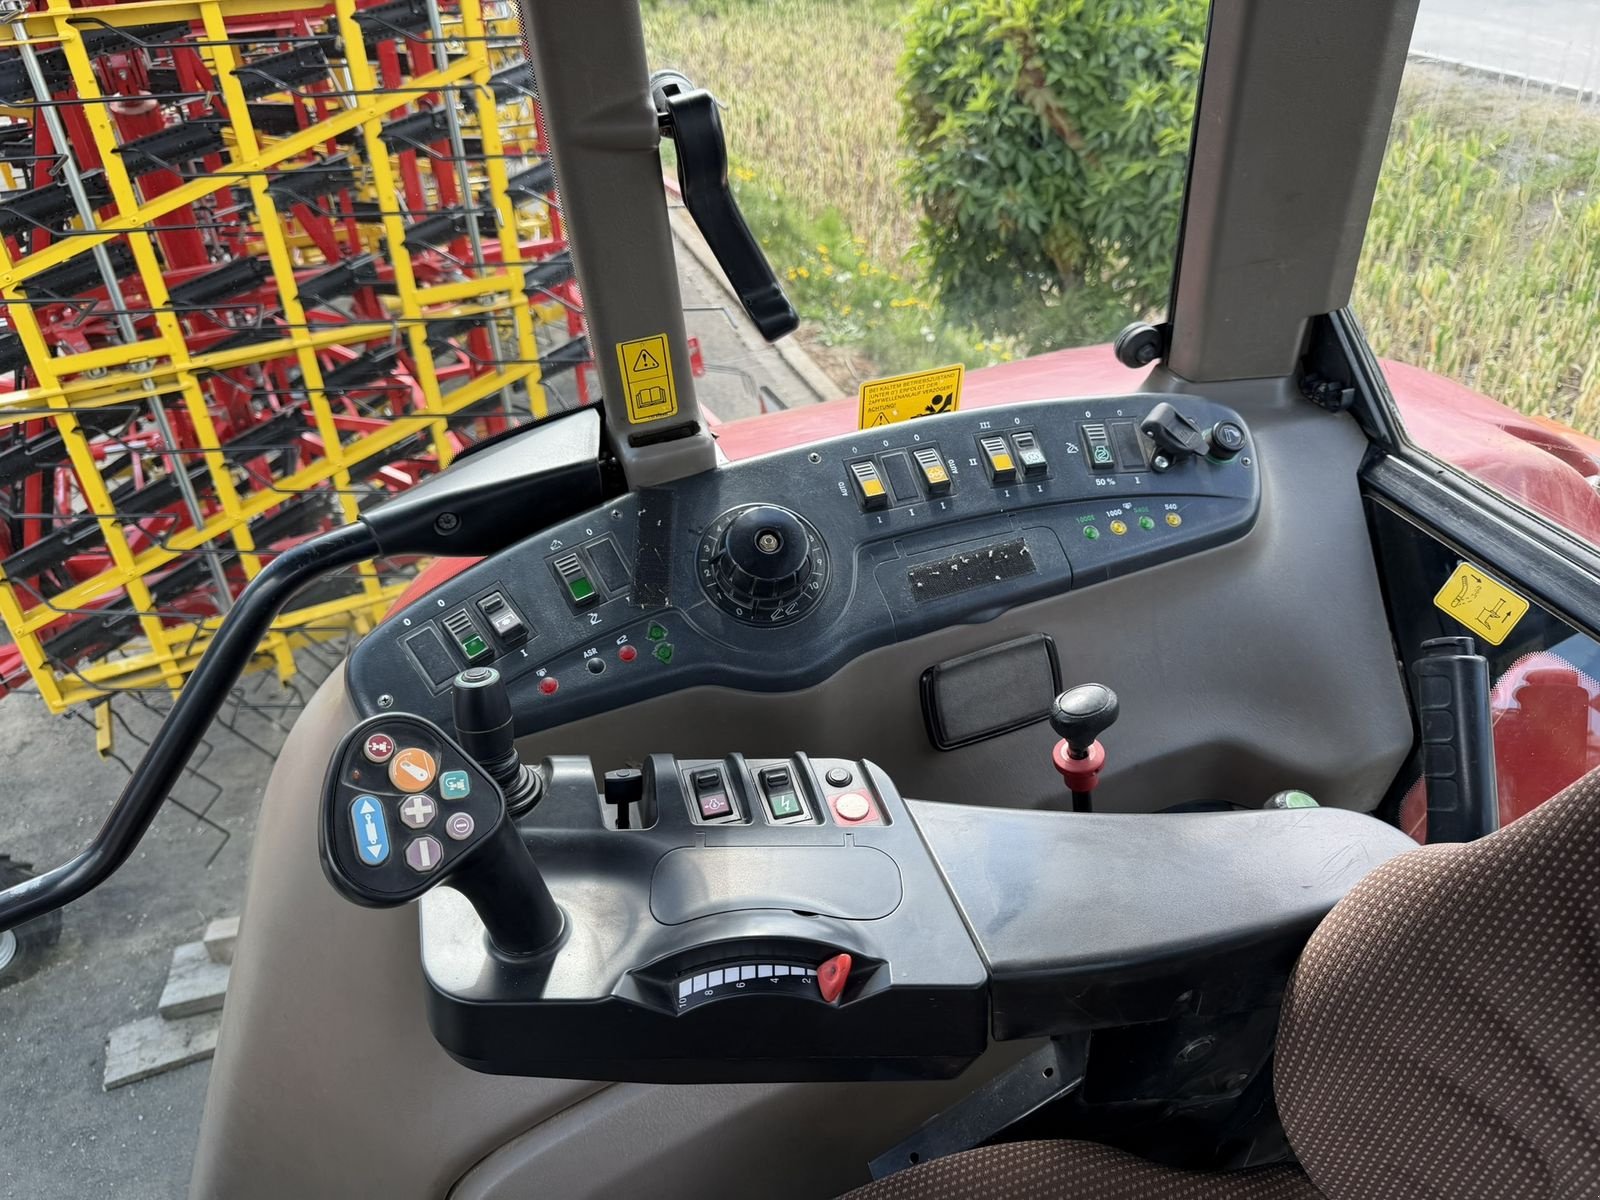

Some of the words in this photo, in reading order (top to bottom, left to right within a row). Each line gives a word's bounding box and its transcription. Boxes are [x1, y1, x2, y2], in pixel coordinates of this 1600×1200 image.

[880, 383, 902, 391] KALTEM
[900, 385, 925, 394] ERFOLGT
[1085, 410, 1091, 418] 0
[979, 421, 991, 429] III
[1014, 417, 1020, 425] 0
[852, 446, 858, 454] 0
[968, 458, 978, 466] II
[947, 459, 959, 474] AUTO
[1095, 478, 1106, 486] 50
[1106, 478, 1116, 486] %
[838, 481, 849, 497] AUTO
[1106, 508, 1123, 518] 1000
[586, 528, 593, 536] 0
[703, 544, 710, 552] 3
[816, 558, 823, 566] 9
[704, 569, 712, 577] 2
[808, 581, 819, 591] 10
[437, 599, 446, 607] 0
[736, 607, 743, 616] 0
[403, 618, 412, 626] 0
[583, 647, 598, 658] ASR
[679, 997, 687, 1008] 10
